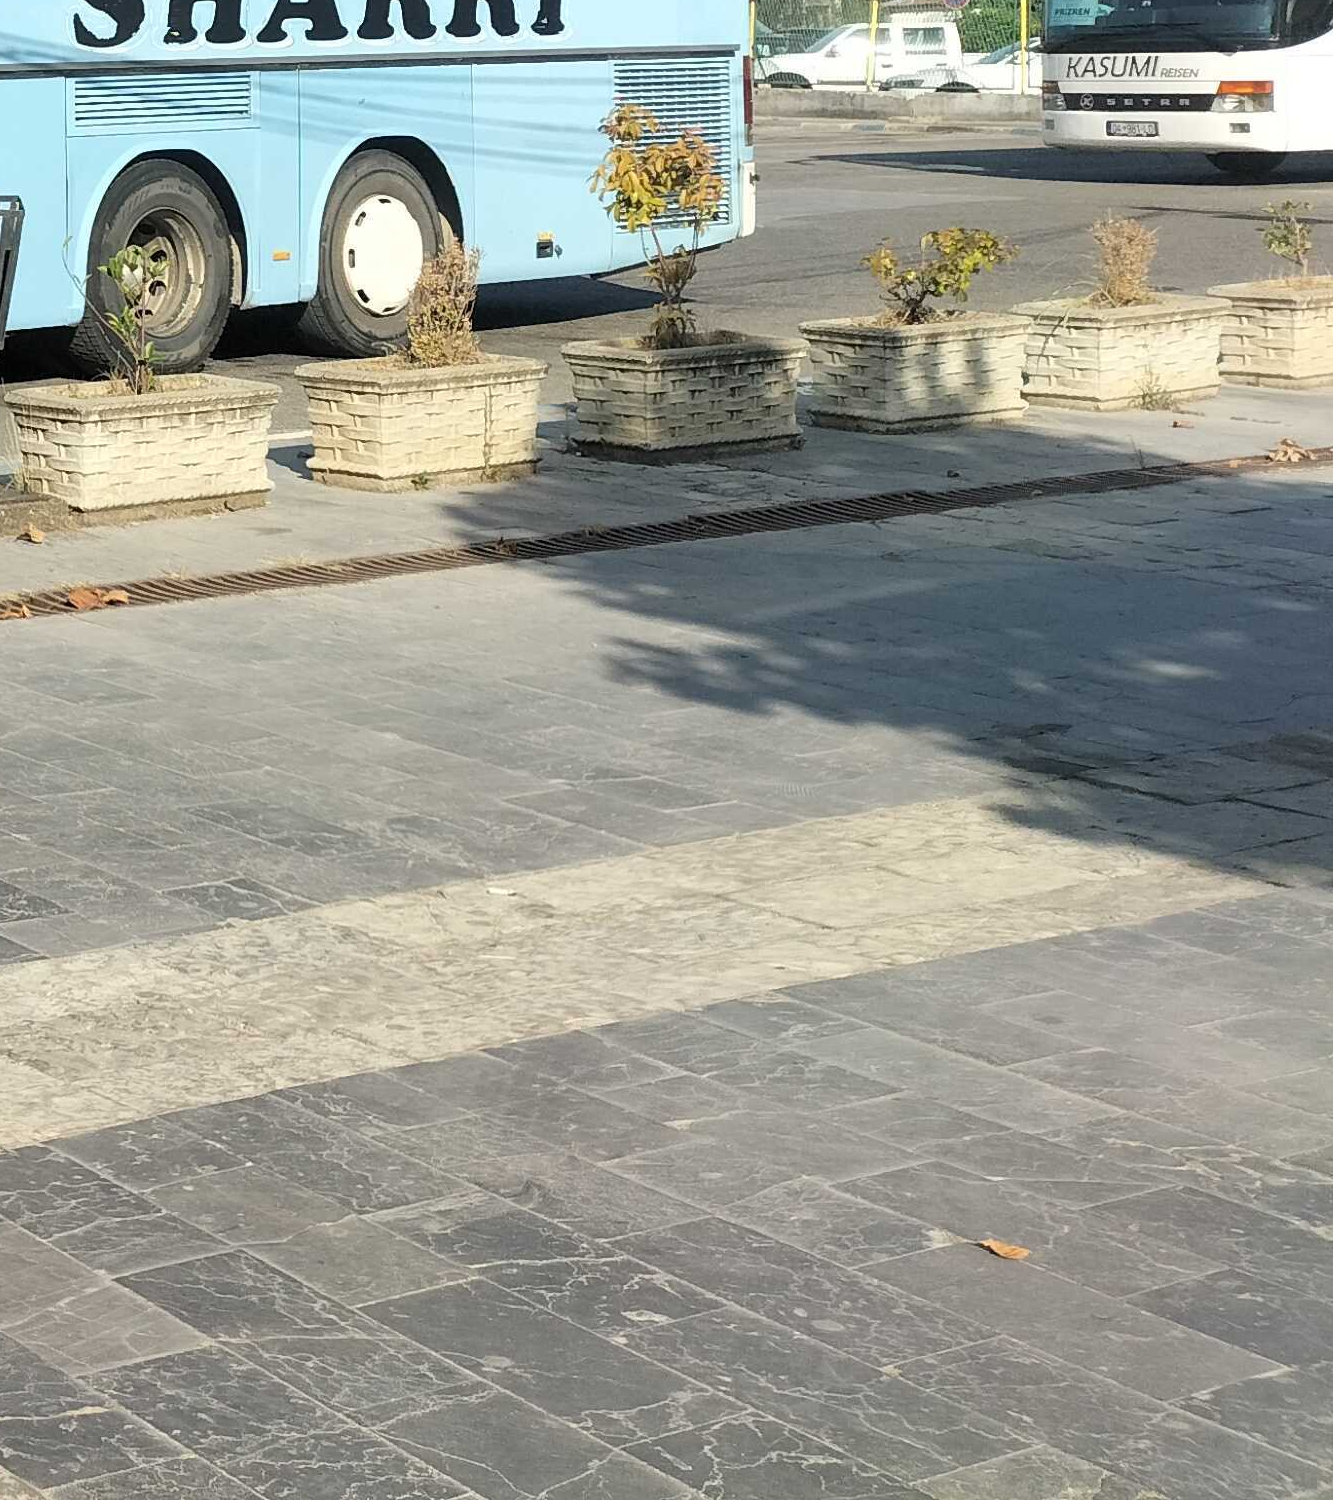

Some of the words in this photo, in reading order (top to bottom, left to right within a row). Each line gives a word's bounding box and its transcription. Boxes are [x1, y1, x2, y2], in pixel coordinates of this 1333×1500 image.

[1066, 55, 1159, 78] KASUMI
[1160, 68, 1199, 78] REISEN
[1107, 98, 1190, 106] SETRA
